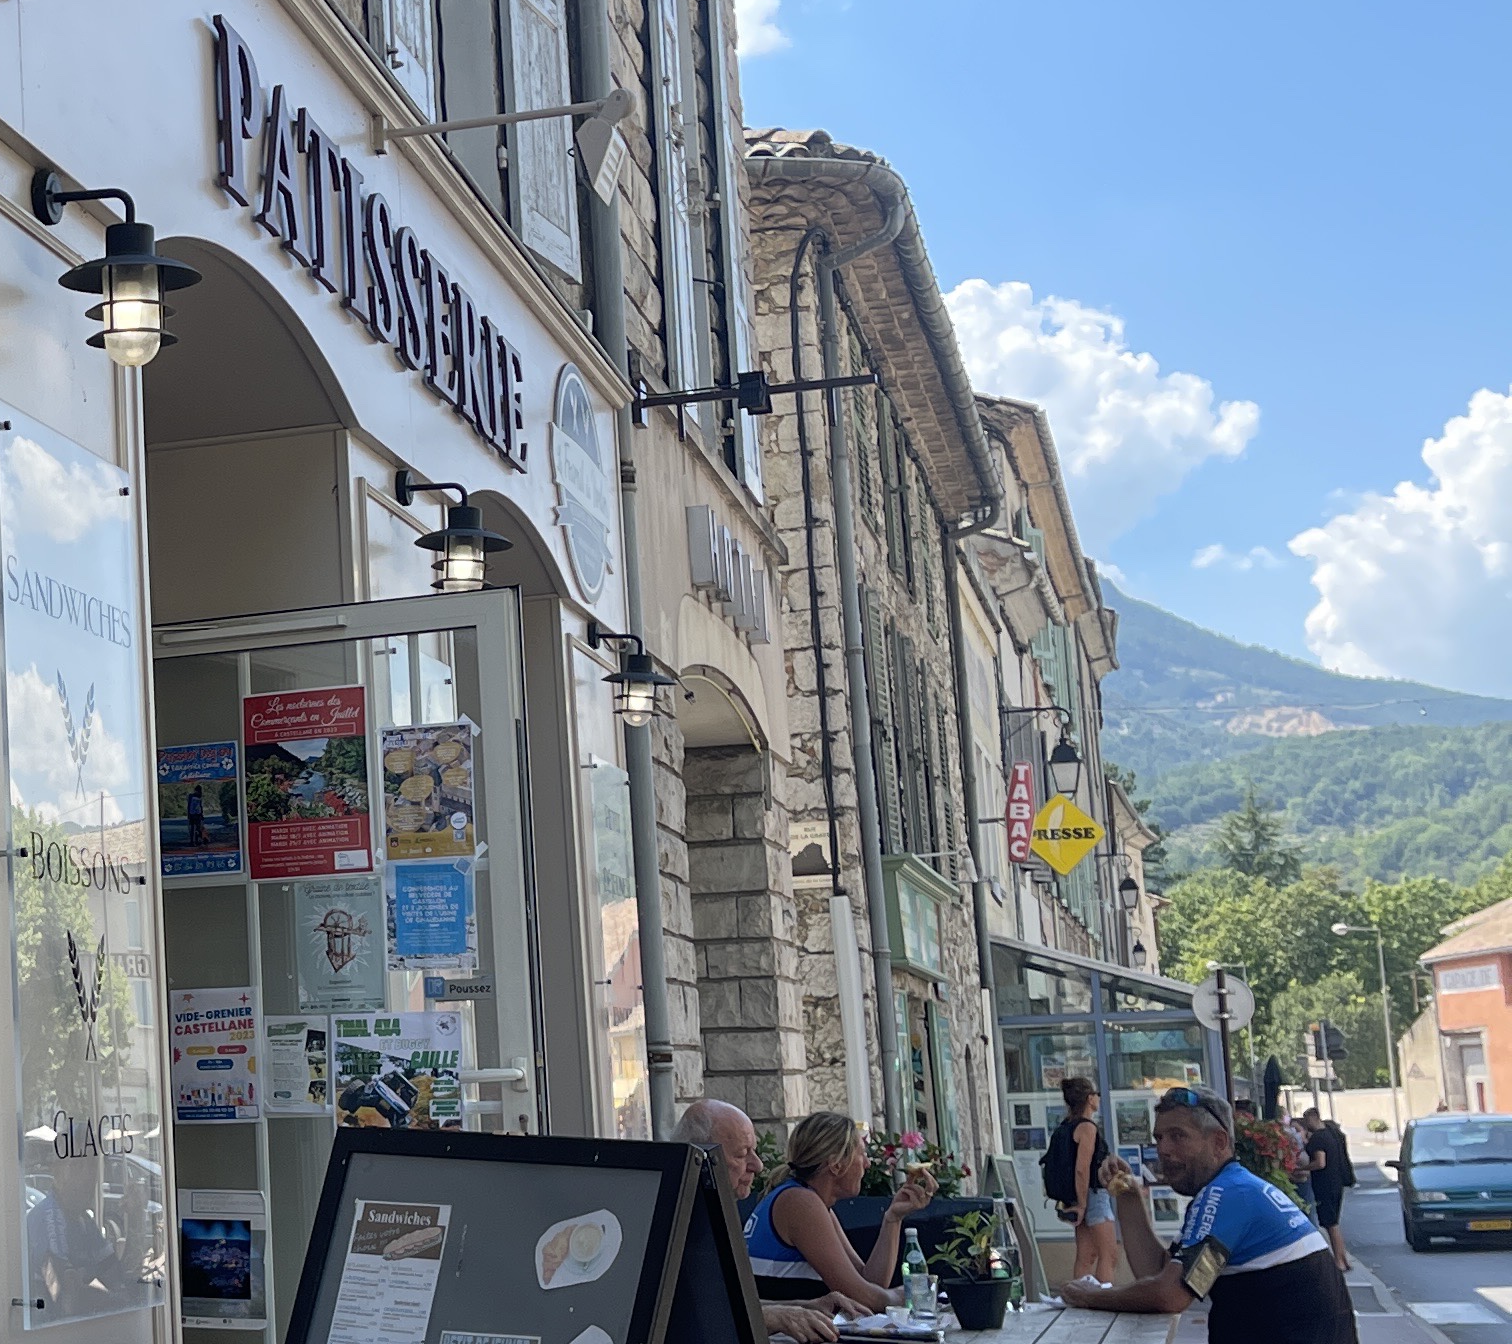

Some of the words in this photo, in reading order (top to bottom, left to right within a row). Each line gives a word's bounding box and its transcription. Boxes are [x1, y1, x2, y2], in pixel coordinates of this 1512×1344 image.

[212, 14, 528, 475] PATISSERIE
[6, 554, 132, 649] SANDWICHES
[1009, 765, 1031, 858] TABAC
[30, 831, 131, 894] BOISSONS
[449, 984, 491, 994] Poussez
[175, 1006, 252, 1023] VIDE-GRENIER
[174, 1018, 255, 1036] CASTELLANE
[229, 1030, 255, 1041] 2023
[338, 1063, 383, 1076] JUILLET
[53, 1110, 134, 1159] GLACES
[367, 1208, 432, 1226] Sandwiches
